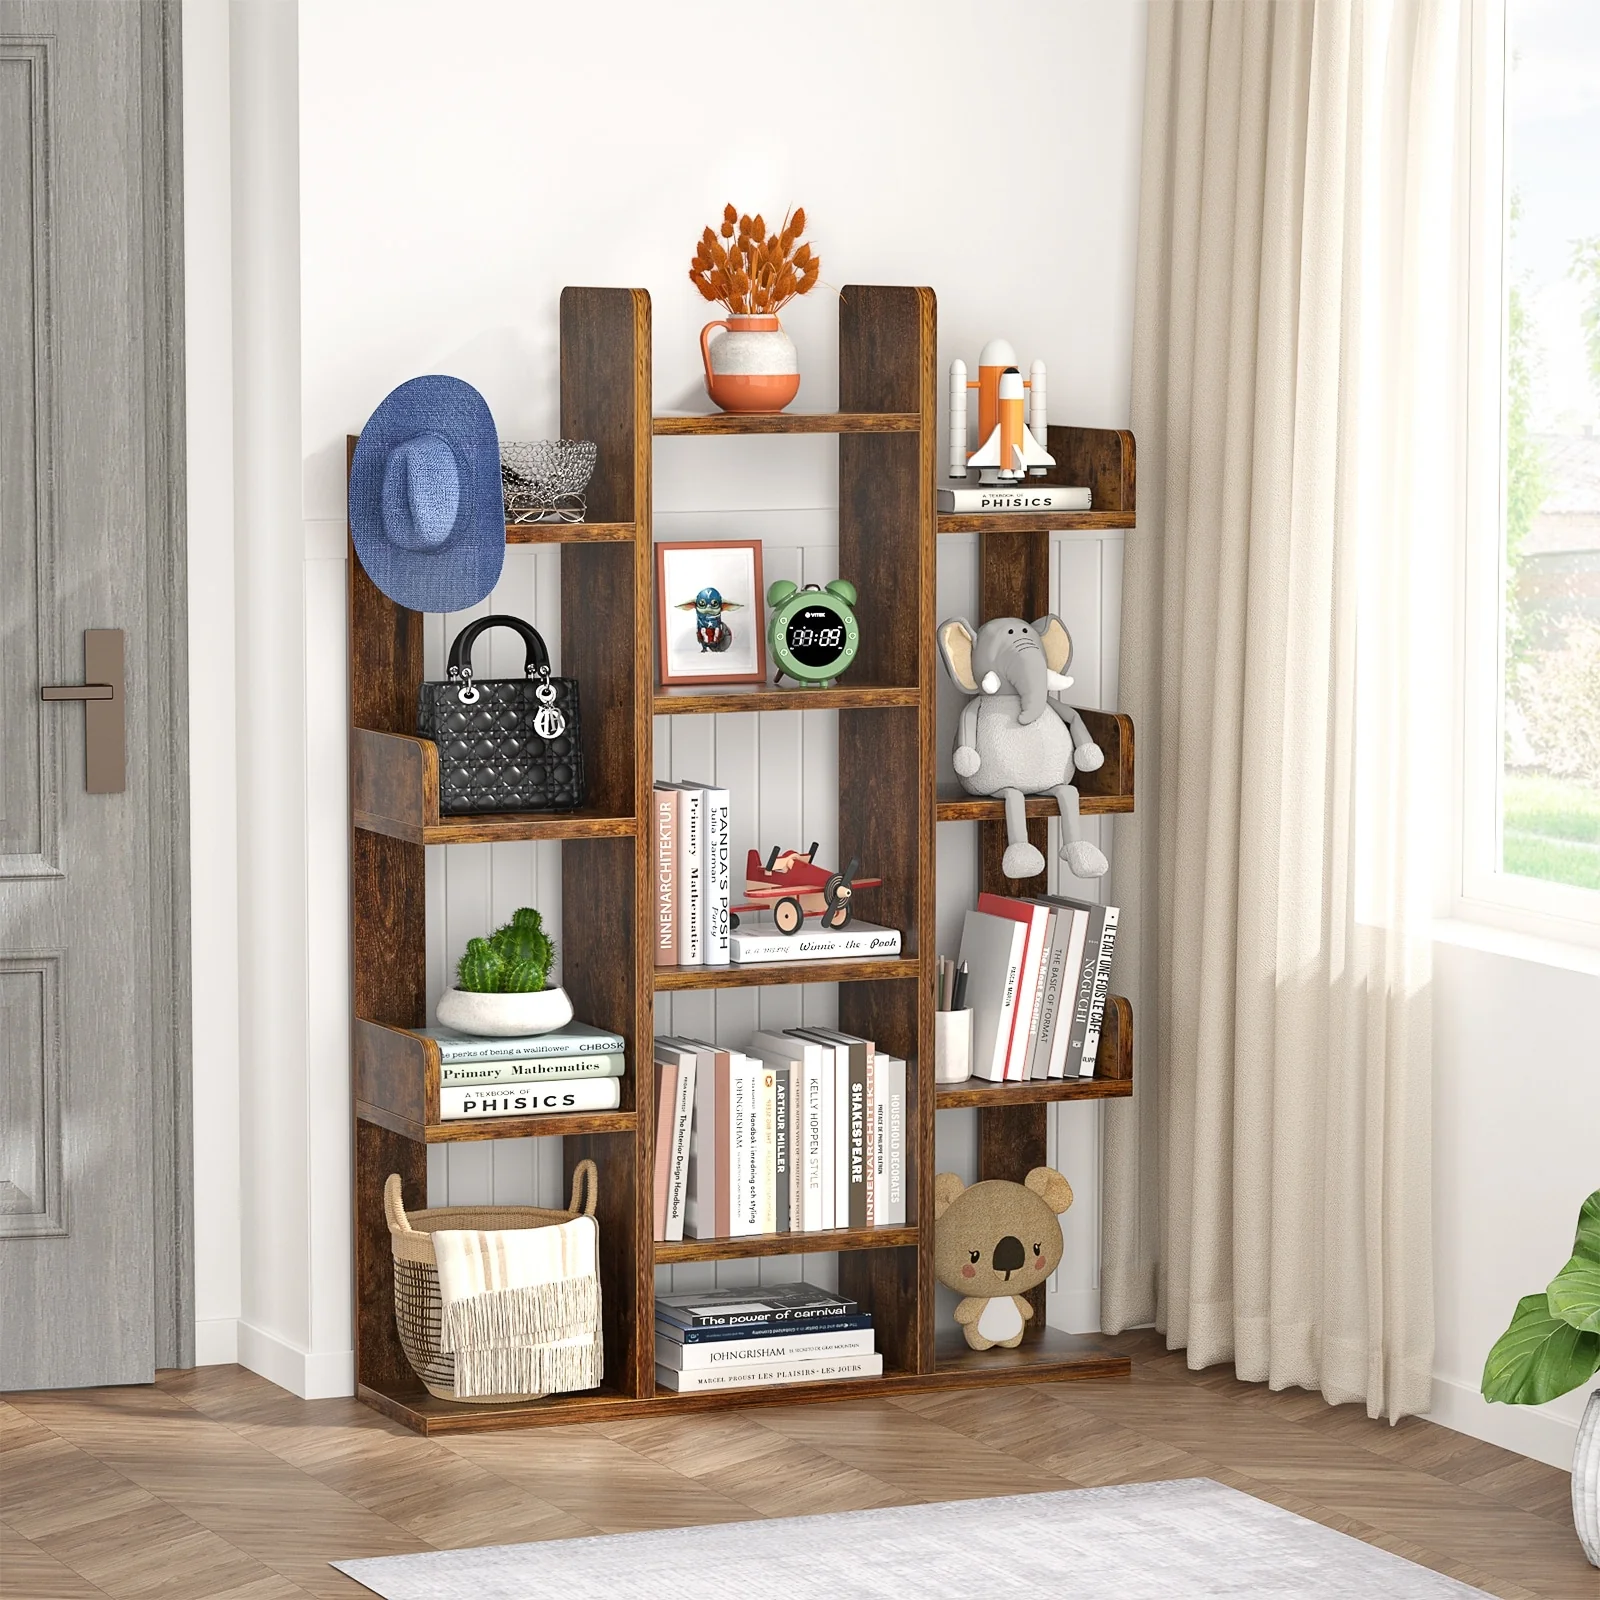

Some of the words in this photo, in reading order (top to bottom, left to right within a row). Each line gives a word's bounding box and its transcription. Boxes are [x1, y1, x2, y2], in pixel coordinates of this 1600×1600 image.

[982, 498, 1052, 508] PHISICS
[689, 798, 698, 857] Primary
[719, 807, 728, 890] PANDA'S
[660, 801, 672, 949] INNENARCHITEKTUR
[690, 867, 699, 958] Mathematics
[711, 906, 719, 937] Party
[719, 897, 728, 949] POSH
[1105, 924, 1117, 932] IL
[800, 941, 836, 951] Winnie
[870, 937, 897, 949] Pooh
[1041, 947, 1050, 964] The
[1101, 934, 1116, 958] ETAIT
[1053, 949, 1062, 964] THE
[1098, 960, 1112, 977] UNE
[1037, 966, 1046, 990] Most
[1048, 967, 1059, 992] BASIC
[1095, 979, 1108, 998] FOIS
[1047, 994, 1055, 1005] OF
[1076, 958, 1096, 1023] NOGUCHI
[1030, 992, 1042, 1035] Excellent
[1093, 1000, 1106, 1010] LE
[1041, 1008, 1052, 1043] FORMAT
[1089, 1012, 1103, 1034] CAFE
[452, 1050, 477, 1059] perks
[490, 1048, 514, 1056] being
[524, 1045, 570, 1053] wallflower
[579, 1042, 624, 1051] CHBOSK
[443, 1069, 501, 1079] Primary
[511, 1062, 600, 1076] Mathematics
[463, 1095, 575, 1112] PHISICS
[475, 1090, 515, 1098] TEXBOOK
[810, 1078, 818, 1110] KELLY
[735, 1078, 743, 1148] JOHNGRISHAM
[777, 1085, 785, 1130] ARTHUR
[679, 1115, 687, 1127] The
[852, 1083, 862, 1183] SHAKESPEARE
[890, 1094, 900, 1149] HOUSEHOLD
[677, 1129, 686, 1154] Interior
[810, 1113, 818, 1155] HOPPEN
[866, 1055, 874, 1221] INNENARCHITEKTUR
[777, 1132, 785, 1173] MILLER
[674, 1156, 683, 1180] Design
[749, 1150, 757, 1184] inredning
[810, 1158, 818, 1188] STYLE
[890, 1151, 900, 1203] DECORATES
[672, 1182, 681, 1219] Handbook
[749, 1200, 757, 1224] styling
[700, 1316, 726, 1326] The
[729, 1313, 771, 1325] power
[775, 1310, 792, 1320] of
[794, 1305, 847, 1318] carnival
[710, 1348, 785, 1362] JOHNGRISHAM
[728, 1374, 756, 1382] PROUST
[776, 1369, 816, 1378] PLAISIRS
